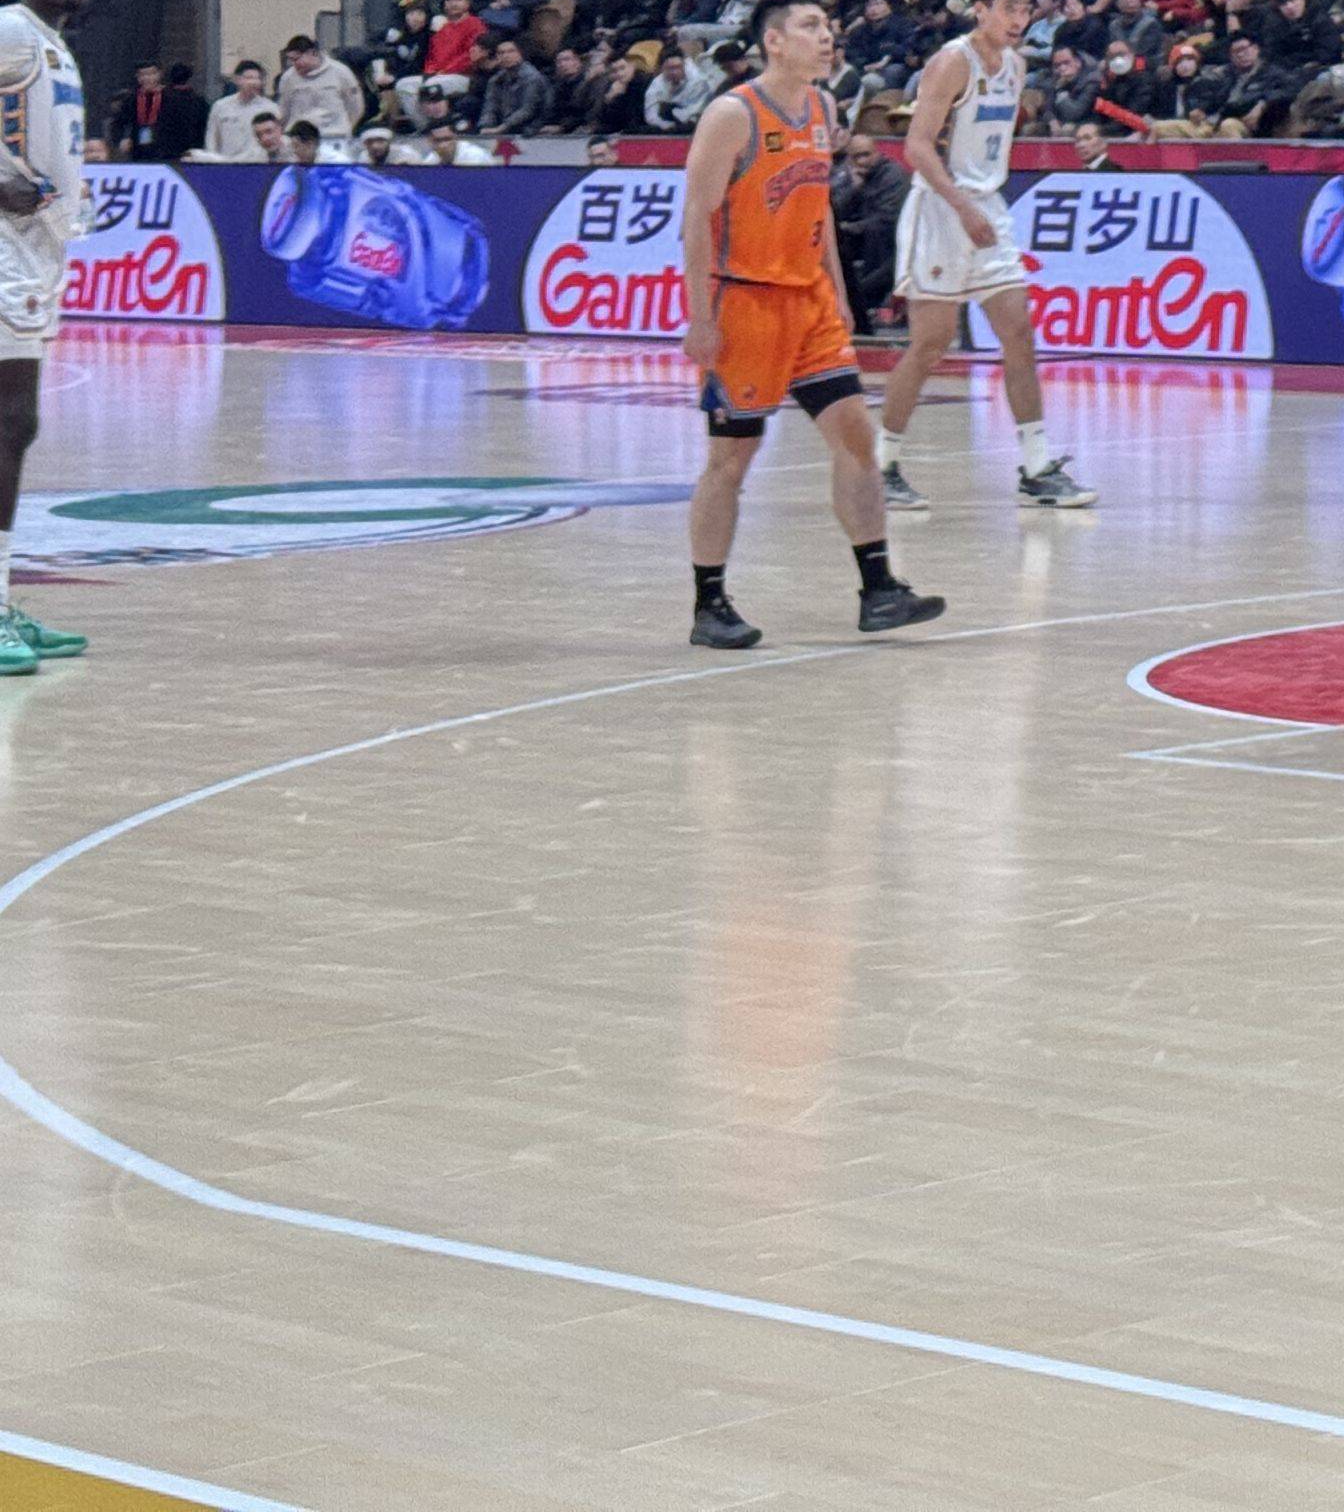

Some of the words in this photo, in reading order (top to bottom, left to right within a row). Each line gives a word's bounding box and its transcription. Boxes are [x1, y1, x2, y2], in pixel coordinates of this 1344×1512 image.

[86, 177, 178, 232] 岁山
[577, 183, 687, 245] 百岁
[1030, 188, 1200, 254] 百岁山
